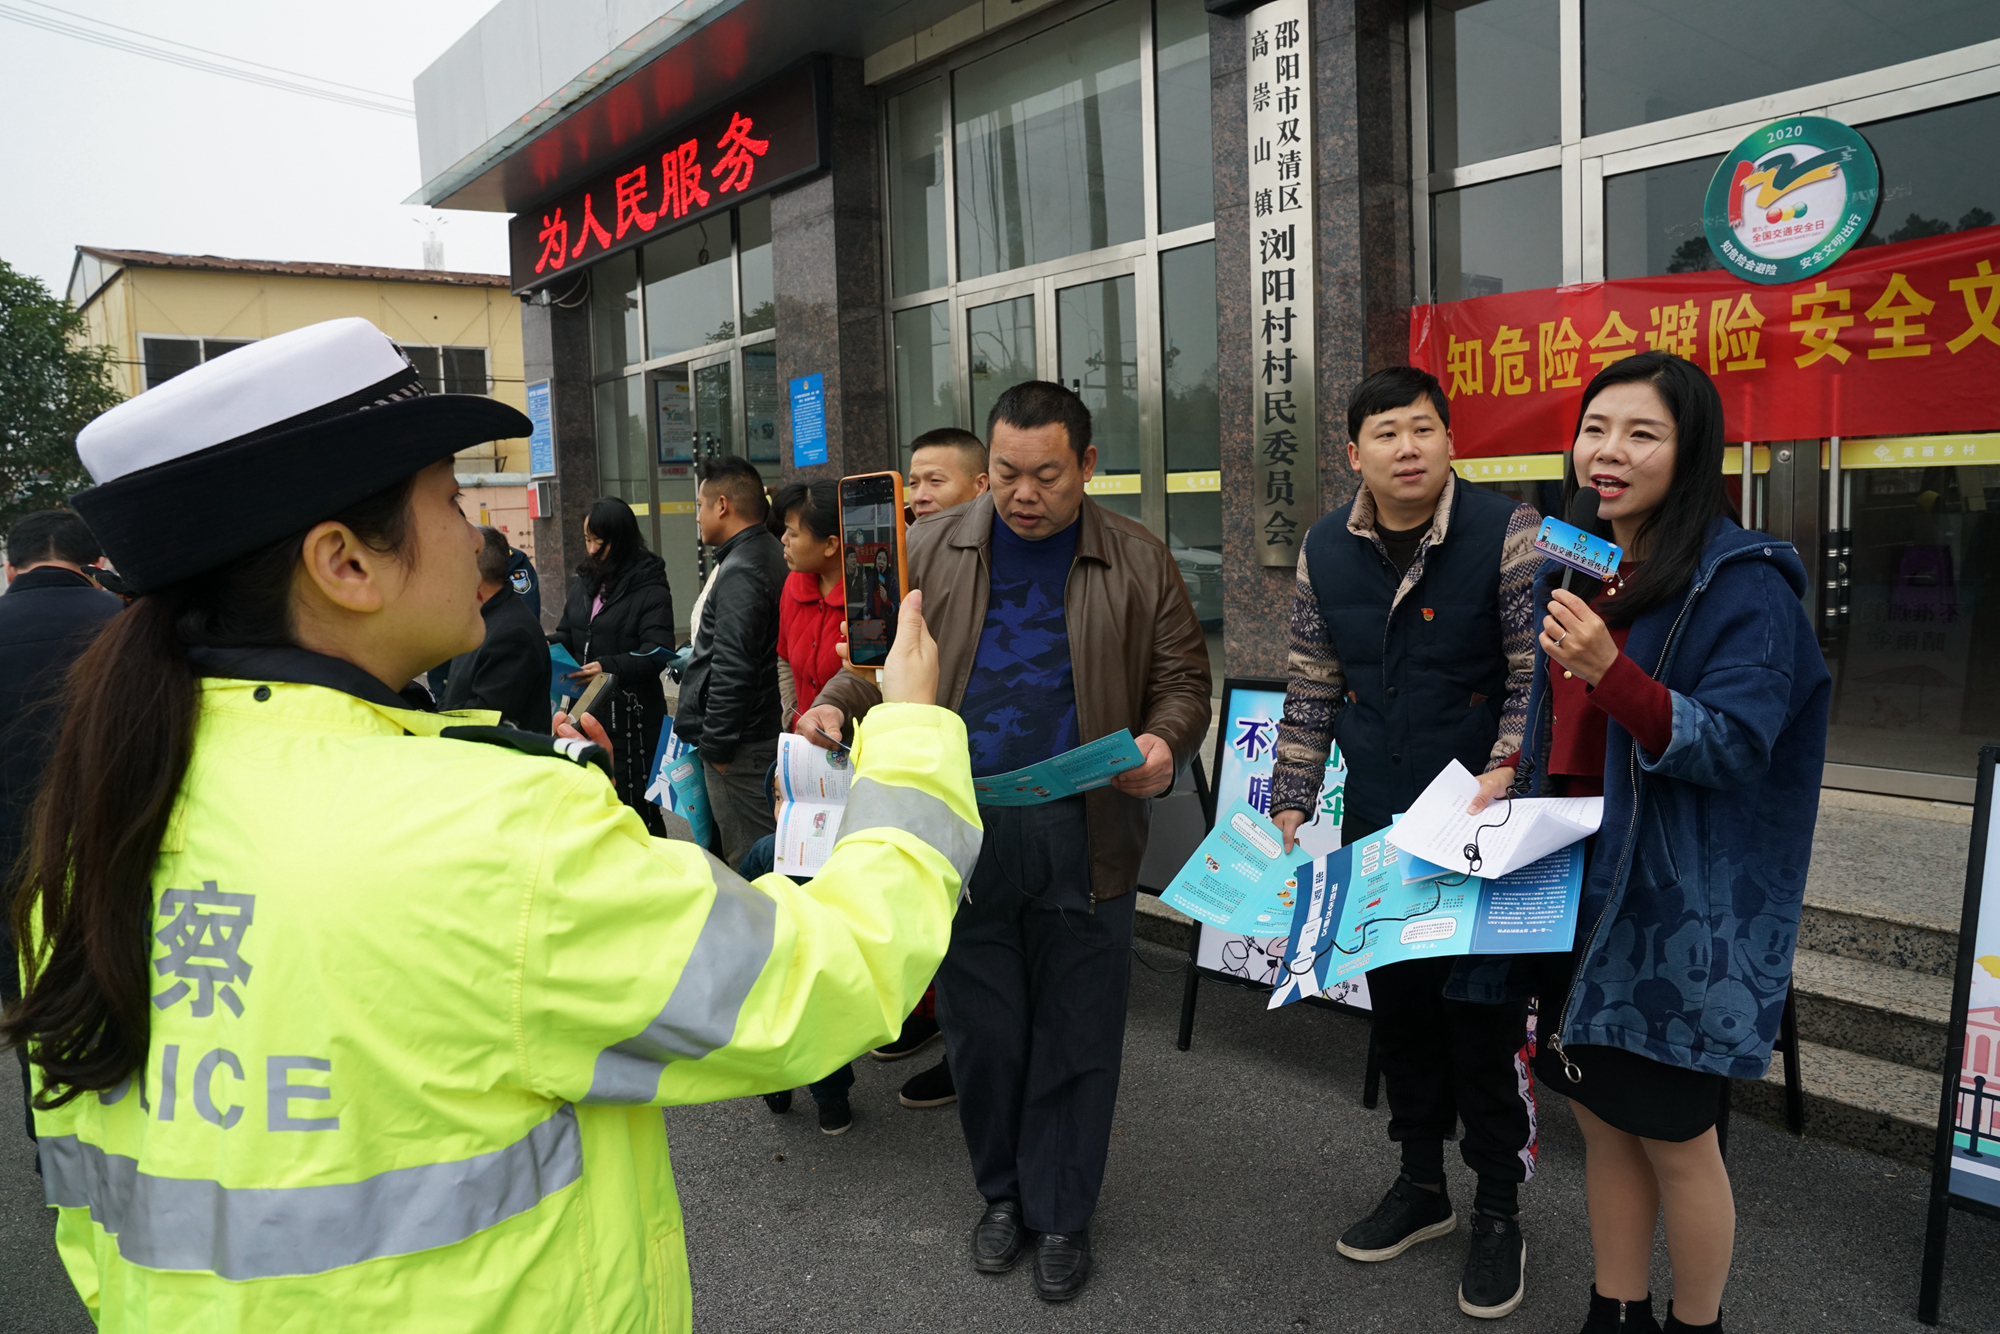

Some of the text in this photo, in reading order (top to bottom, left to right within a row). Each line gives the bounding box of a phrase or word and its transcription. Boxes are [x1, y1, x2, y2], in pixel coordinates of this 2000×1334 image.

[1251, 29, 1274, 219] 高崇山镇
[1273, 19, 1303, 213] 邵阳市双清区
[1767, 125, 1803, 143] 2020
[535, 111, 769, 273] 为人民服务
[1720, 240, 1778, 276] 知危险会避险
[1752, 219, 1825, 243] 全国交通安全日
[1799, 213, 1862, 270] 安全文明出行
[1790, 258, 2000, 369] 安全文
[1259, 223, 1299, 547] 浏阳村村民委员会
[1902, 444, 1976, 458] 美丽乡村
[1542, 540, 1609, 574] 全国交通安全宣传日
[1573, 541, 1588, 554] 122
[151, 880, 256, 1018] 察
